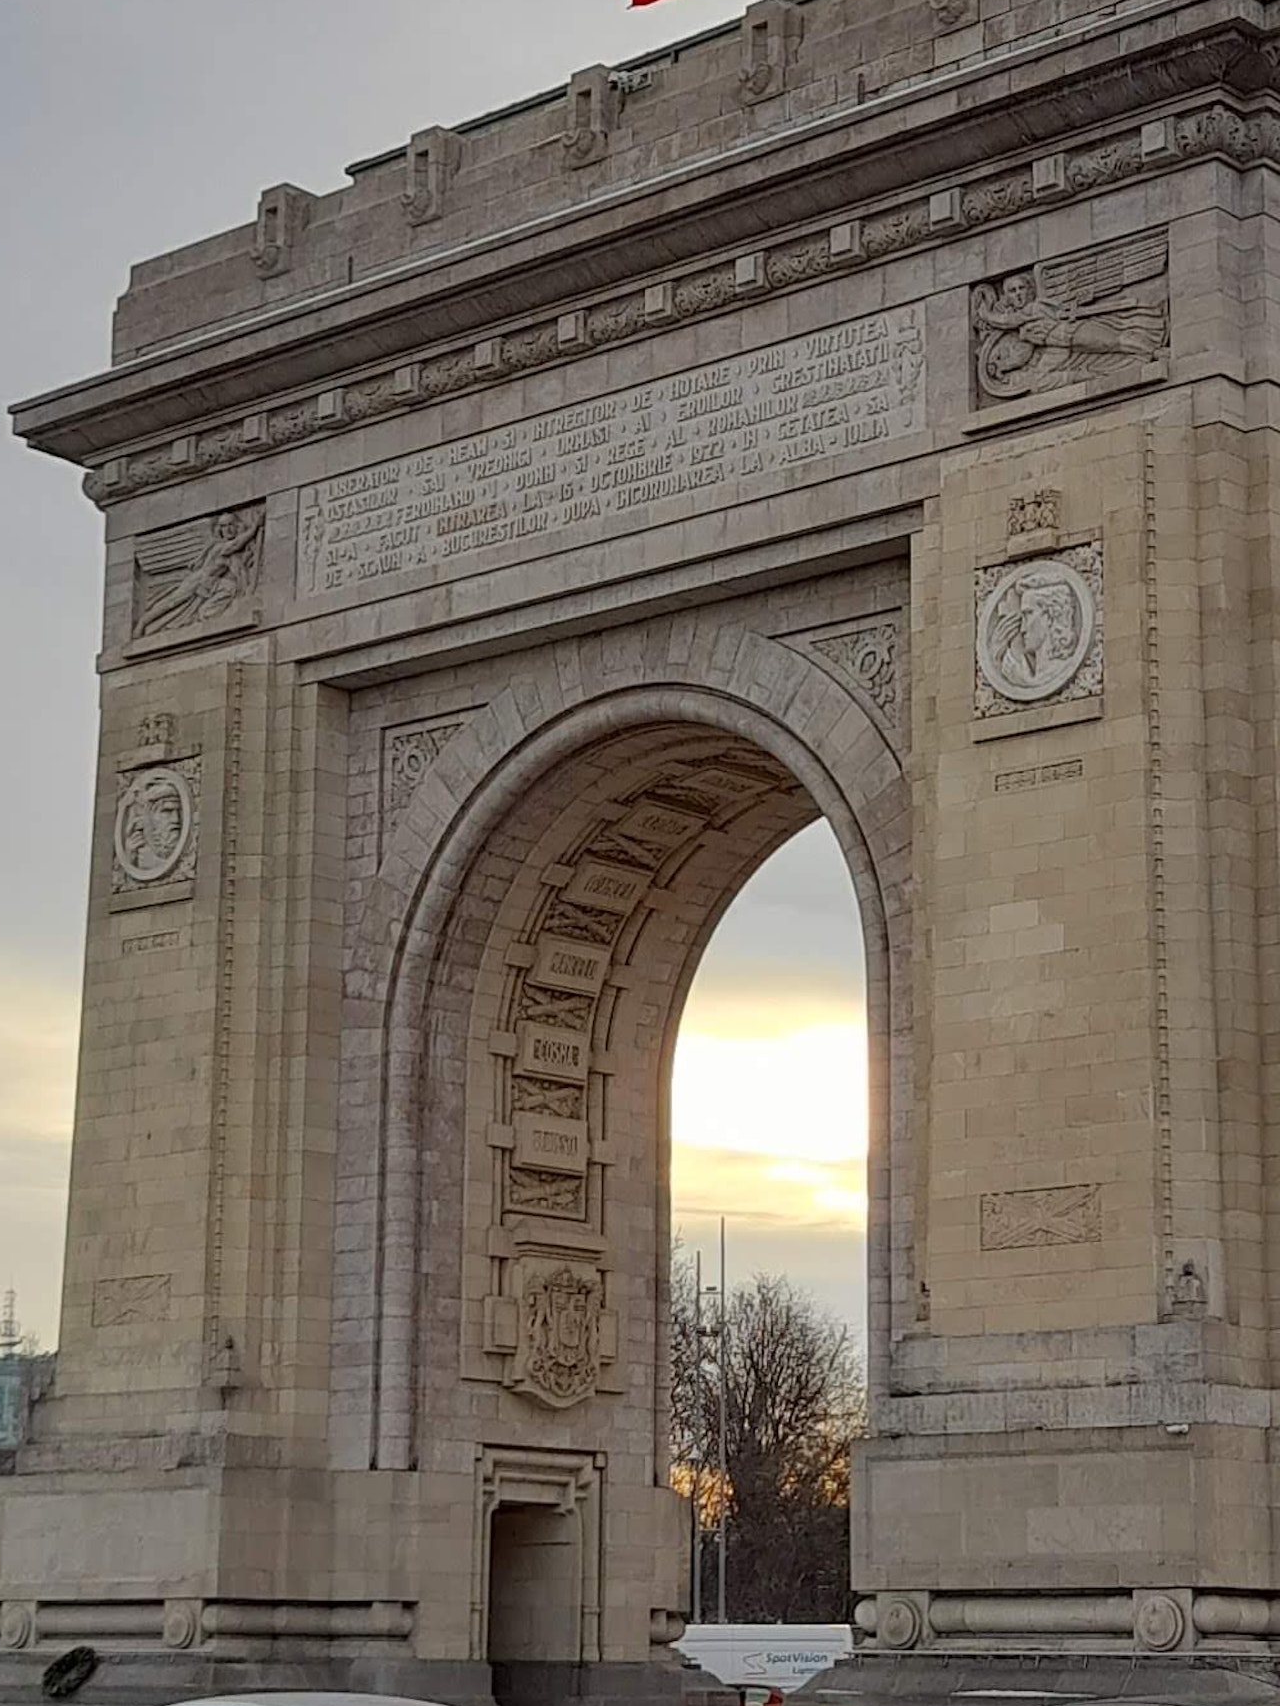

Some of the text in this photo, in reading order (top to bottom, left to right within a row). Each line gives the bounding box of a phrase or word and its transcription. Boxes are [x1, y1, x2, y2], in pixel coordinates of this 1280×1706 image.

[326, 465, 400, 502] LIBERATOR
[413, 455, 434, 477] DE
[631, 389, 653, 413] DE
[804, 317, 889, 360] VIRTUTEA
[676, 385, 744, 422] EROILOR
[521, 492, 546, 514] LA
[689, 438, 725, 467] 1922
[606, 437, 646, 466] REGE
[325, 568, 345, 590] DE
[740, 451, 764, 476] LA
